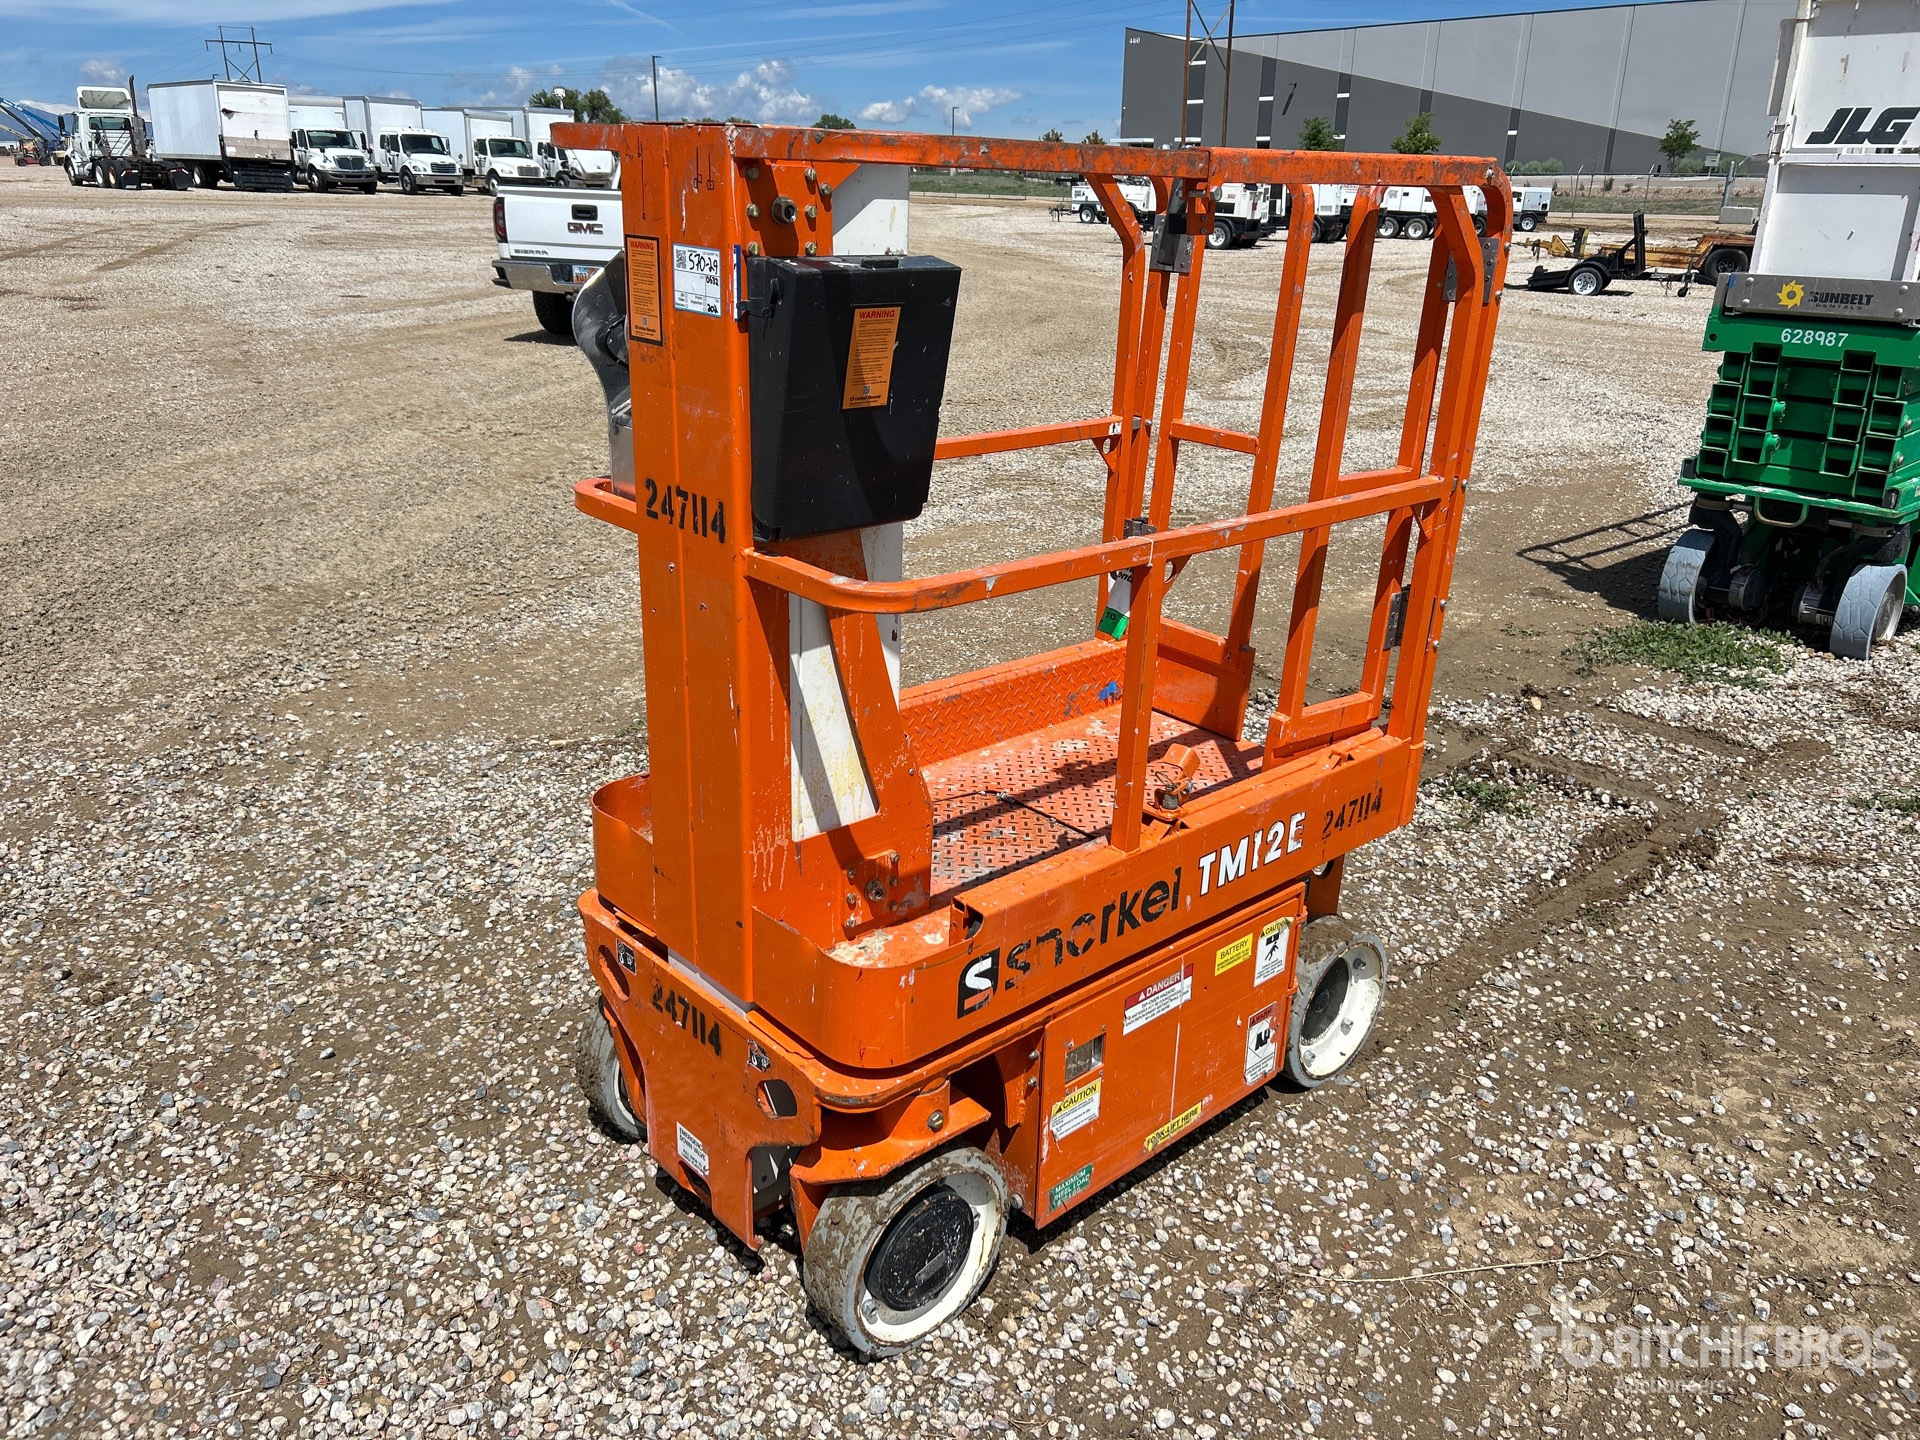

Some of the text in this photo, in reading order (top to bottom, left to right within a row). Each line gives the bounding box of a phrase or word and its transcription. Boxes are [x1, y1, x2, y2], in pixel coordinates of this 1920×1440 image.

[1805, 107, 1920, 144] JLG
[567, 222, 603, 235] GMC
[630, 240, 654, 250] WARNING
[1808, 291, 1874, 305] SUNBELT
[859, 310, 895, 319] WARNING
[1781, 328, 1849, 347] 628987
[645, 478, 726, 544] 247114
[1198, 810, 1306, 897] TM12E
[1322, 787, 1383, 840] 247114
[1220, 939, 1248, 959] BATTERY
[1146, 972, 1181, 997] DANGER
[652, 984, 722, 1056] 247114
[1062, 1084, 1097, 1109] CAUTION
[1181, 1107, 1199, 1122] HERE
